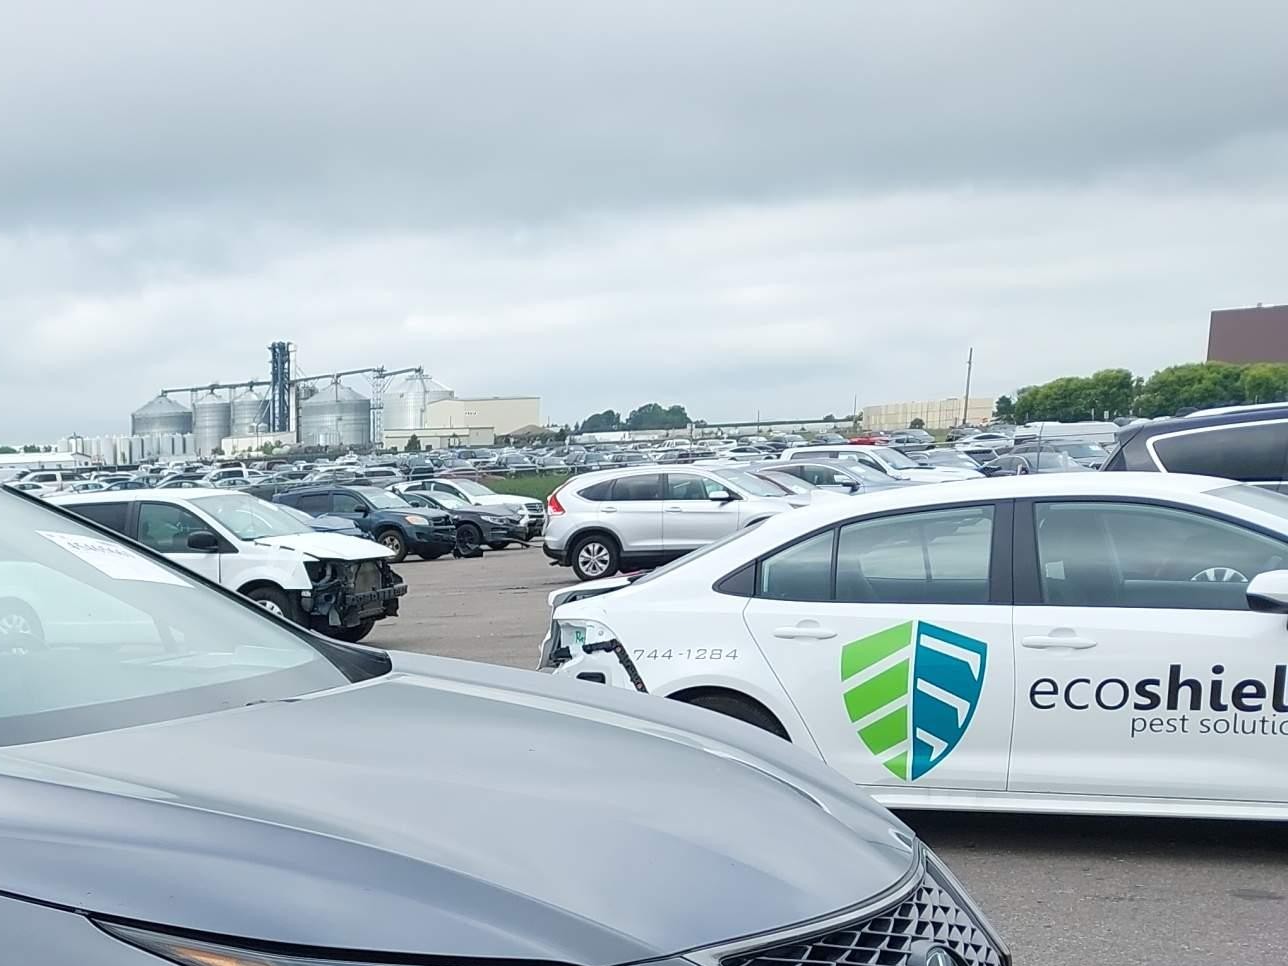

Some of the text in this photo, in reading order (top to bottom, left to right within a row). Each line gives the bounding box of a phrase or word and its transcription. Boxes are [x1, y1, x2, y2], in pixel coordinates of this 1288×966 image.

[634, 648, 739, 661] 744-1284
[1029, 664, 1288, 713] ecoshiel
[1131, 714, 1189, 738] pest
